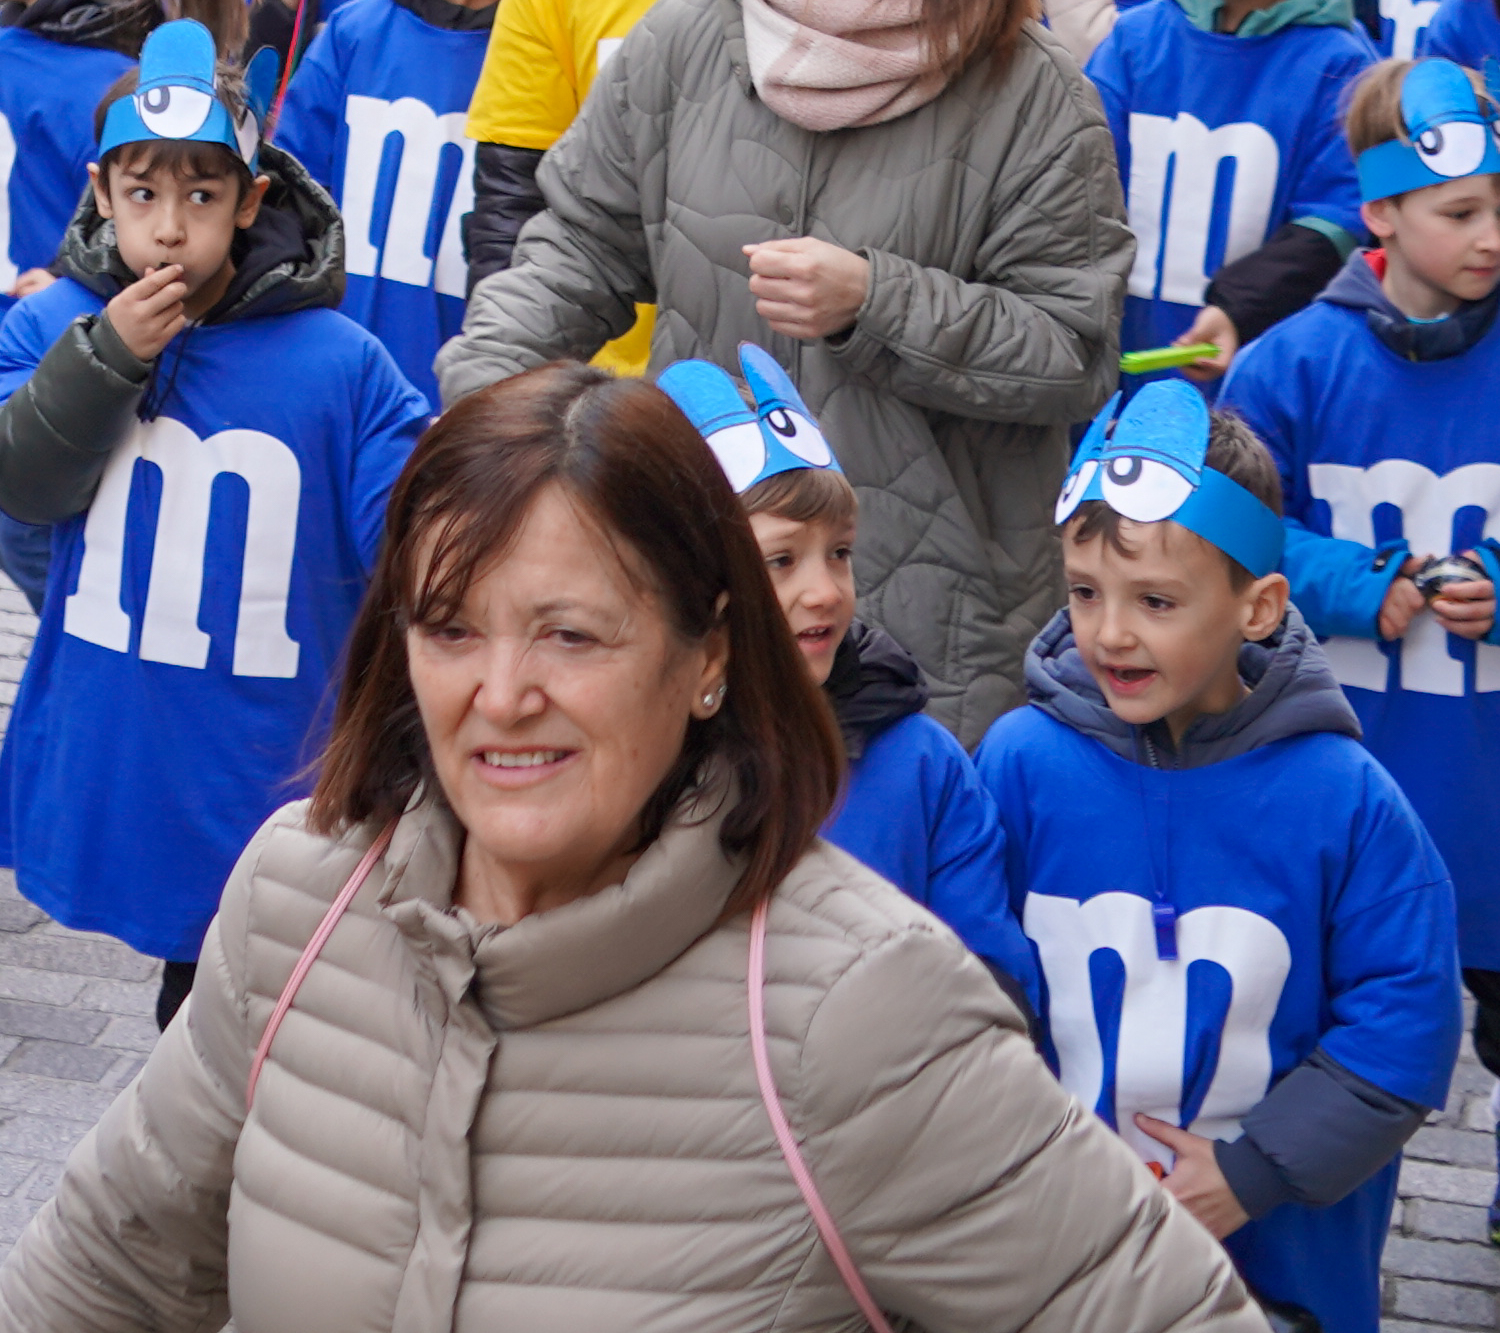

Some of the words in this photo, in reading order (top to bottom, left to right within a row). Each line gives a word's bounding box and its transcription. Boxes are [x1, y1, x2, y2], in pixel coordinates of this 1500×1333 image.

[345, 94, 475, 300] m
[1127, 112, 1280, 307] m
[64, 416, 302, 679] m
[1023, 890, 1292, 1176] m
